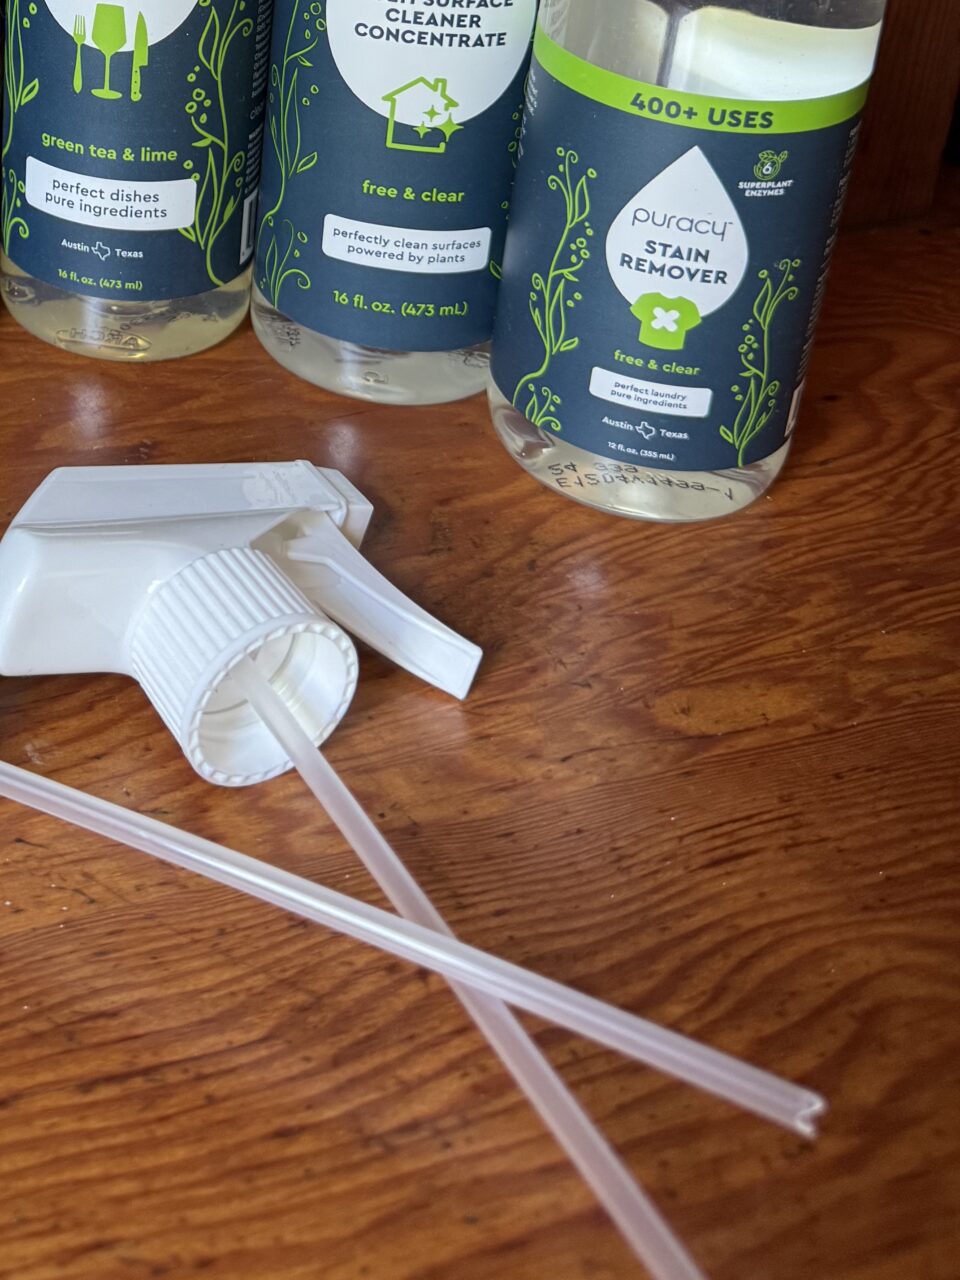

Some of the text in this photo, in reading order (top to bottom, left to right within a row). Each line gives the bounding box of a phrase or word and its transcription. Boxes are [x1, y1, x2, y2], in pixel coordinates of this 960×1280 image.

[385, 8, 482, 28] CLEANER
[354, 22, 507, 47] CONCENTRATE
[630, 92, 774, 130] 400+ USES
[41, 132, 178, 162] green tea & lime
[763, 162, 772, 175] 6
[52, 178, 160, 203] perfect dishes
[362, 179, 465, 203] free & clear
[738, 179, 793, 191] SUPERPLANT
[744, 188, 785, 197] ENZYMES
[45, 190, 168, 220] pure ingredients
[61, 238, 144, 258] Austin Texas
[333, 226, 482, 251] perfectly clean surfaces
[347, 244, 466, 264] powered by plants
[645, 240, 709, 264] STAIN
[58, 268, 68, 280] 16
[69, 270, 80, 283] fl.
[80, 276, 96, 287] oz.
[99, 276, 122, 290] (473
[620, 253, 728, 285] REMOVER
[333, 290, 468, 317] 16 fl. oz. (473 mL)
[614, 349, 700, 376] free & clear
[611, 388, 687, 410] pure ingredients
[614, 381, 687, 401] perfect laundry
[602, 416, 689, 440] Austin Texas
[607, 441, 617, 449] 12
[640, 448, 658, 459] (355
[659, 452, 676, 462] mL)
